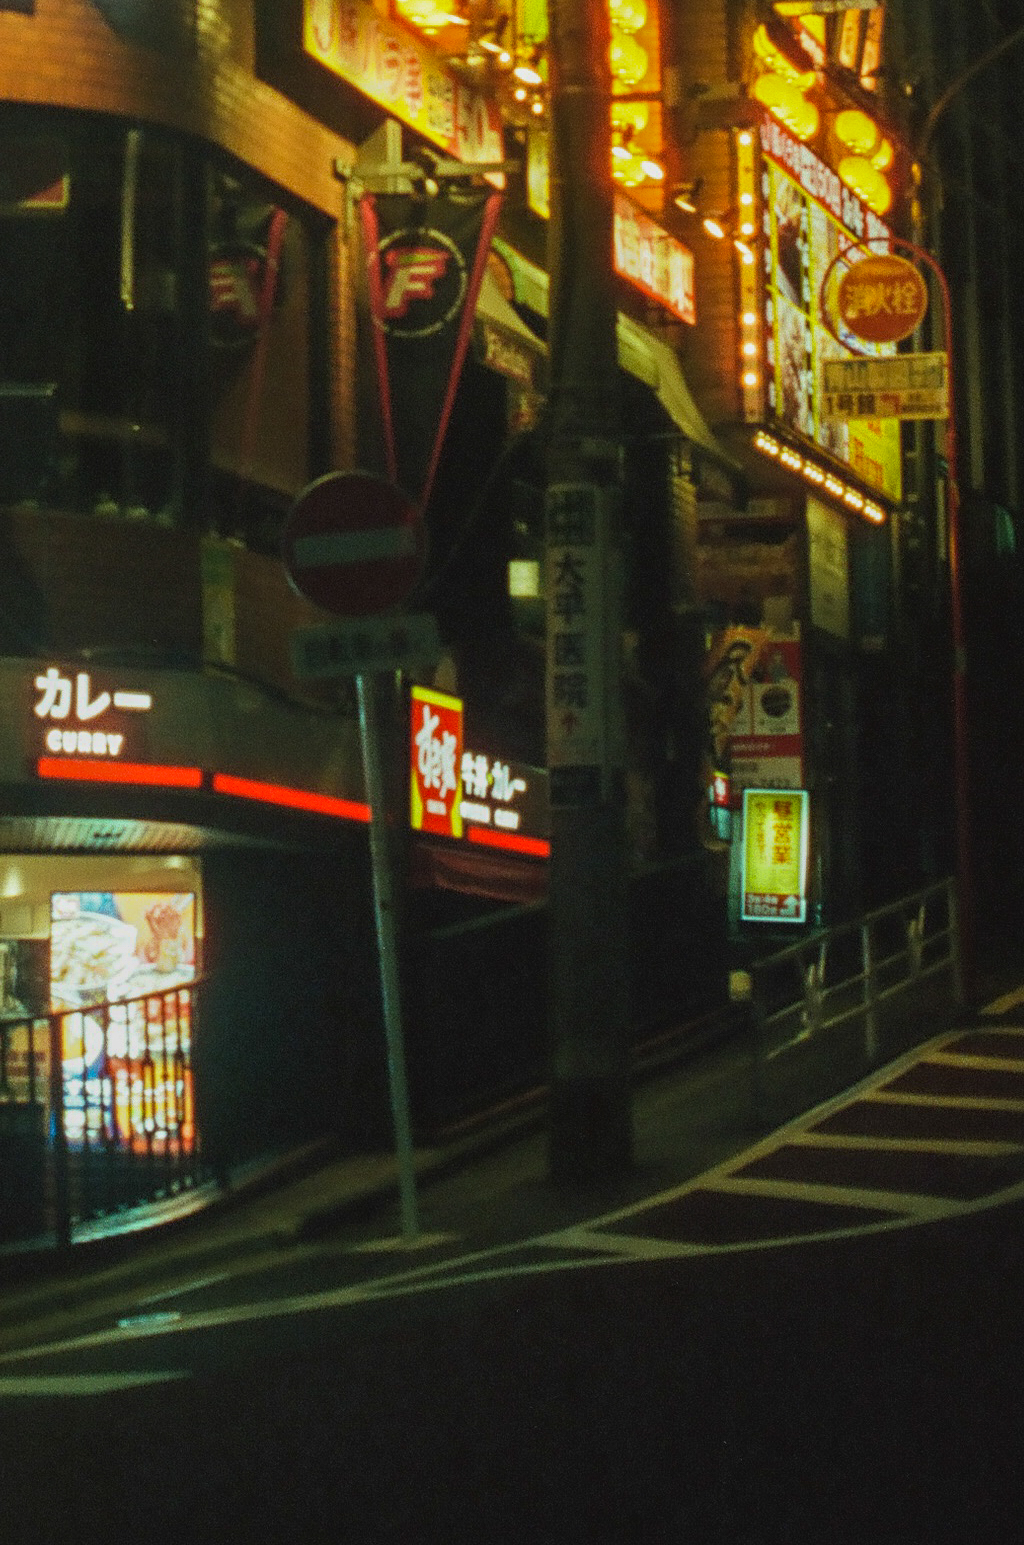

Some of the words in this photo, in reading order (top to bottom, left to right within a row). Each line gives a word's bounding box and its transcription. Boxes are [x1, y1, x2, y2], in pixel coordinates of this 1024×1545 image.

[34, 668, 153, 721] カレー
[46, 729, 124, 755] CURRY
